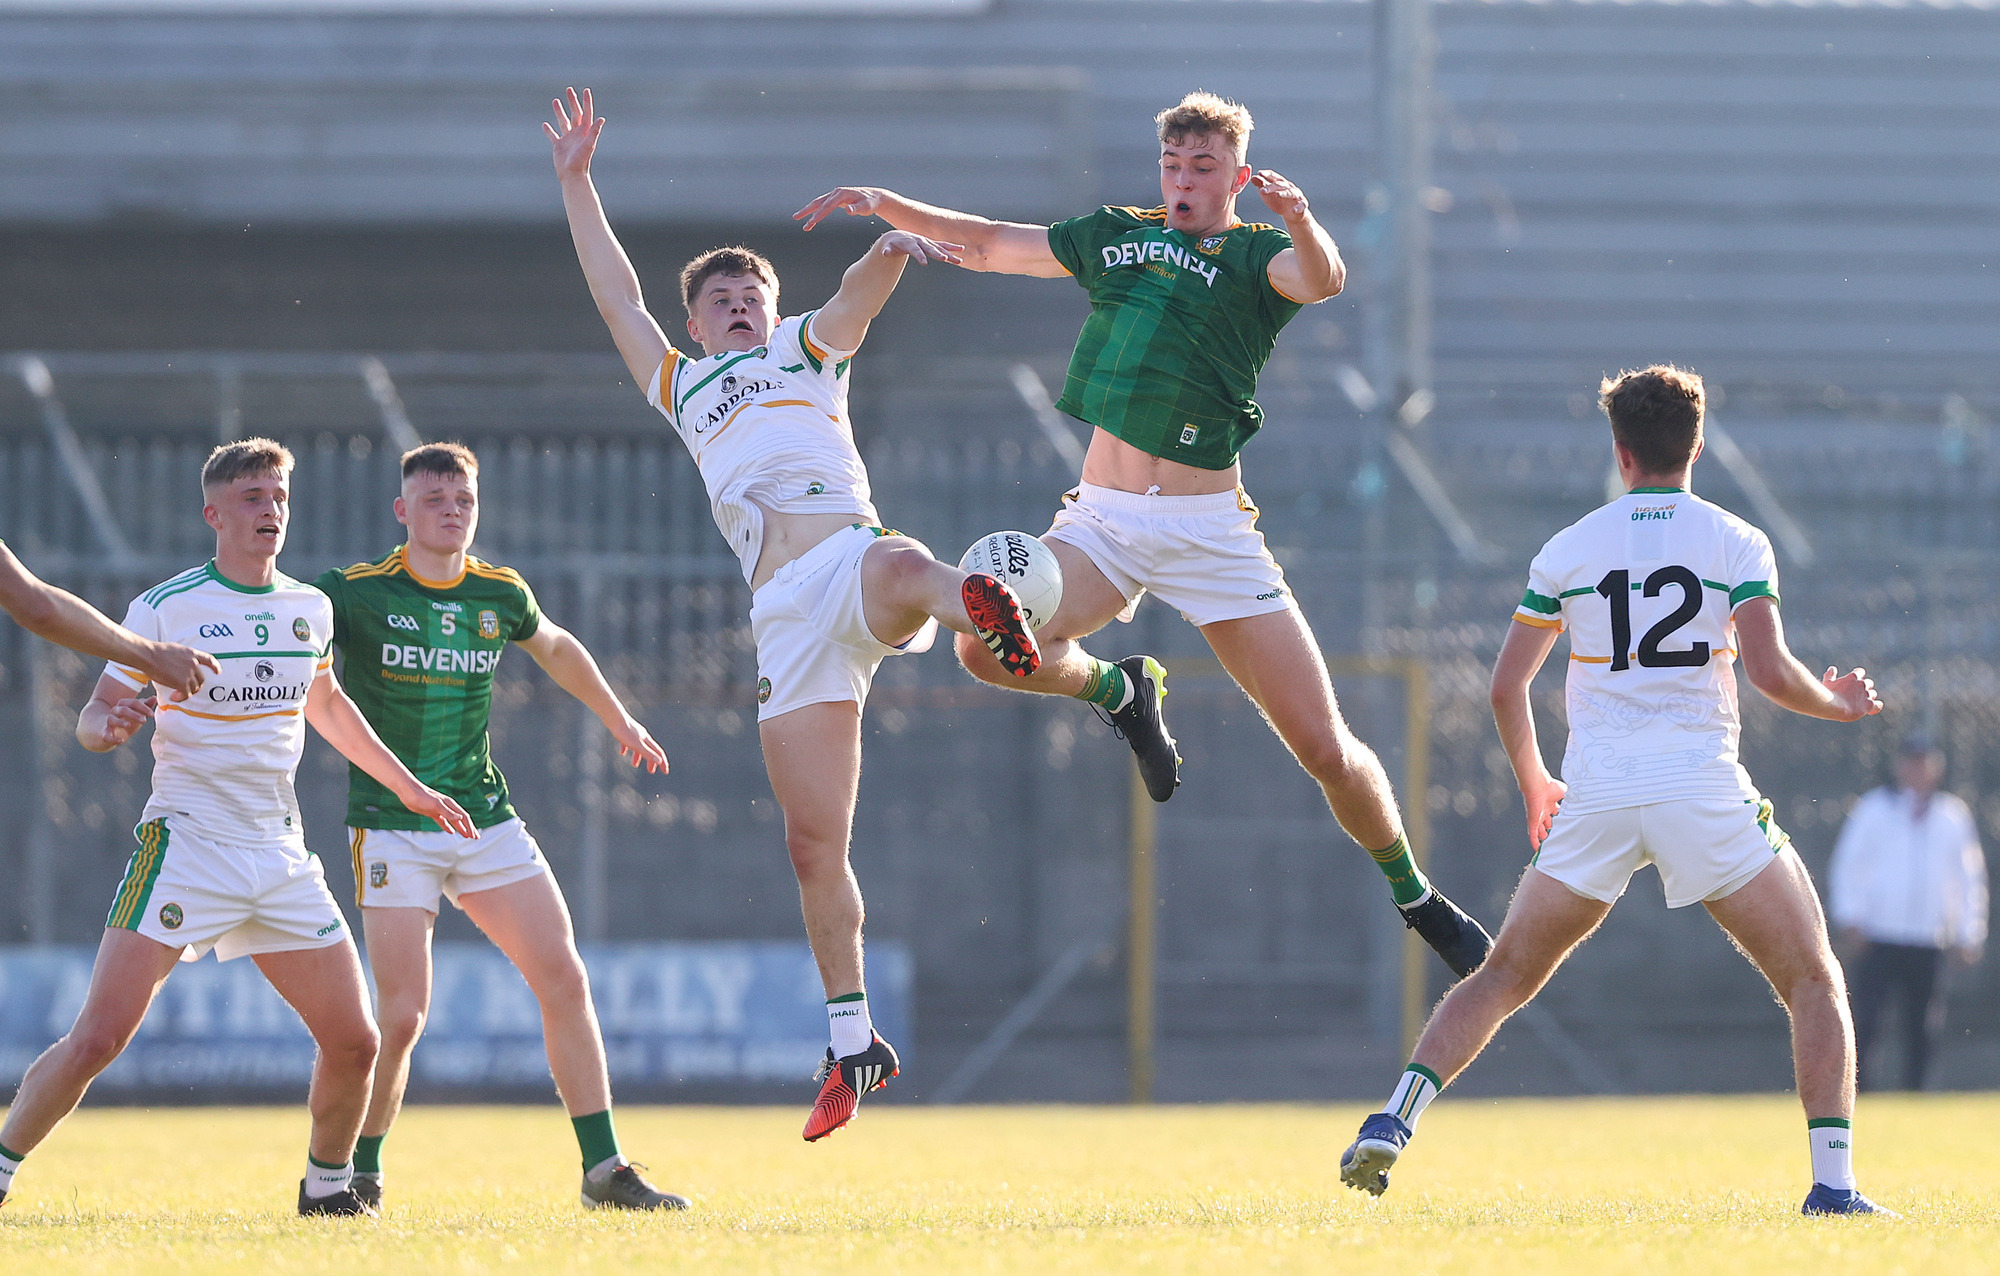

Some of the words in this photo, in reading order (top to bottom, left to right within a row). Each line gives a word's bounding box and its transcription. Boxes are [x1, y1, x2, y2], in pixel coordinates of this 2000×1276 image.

[1631, 511, 1675, 521] OFFALY
[387, 614, 420, 631] GAA
[441, 612, 456, 636] 5
[1595, 565, 1711, 672] 12
[200, 623, 234, 638] GAA
[254, 623, 269, 646] 9
[381, 643, 500, 674] DEVENISH
[381, 669, 420, 684] Beyond
[421, 673, 466, 687] Nutrition
